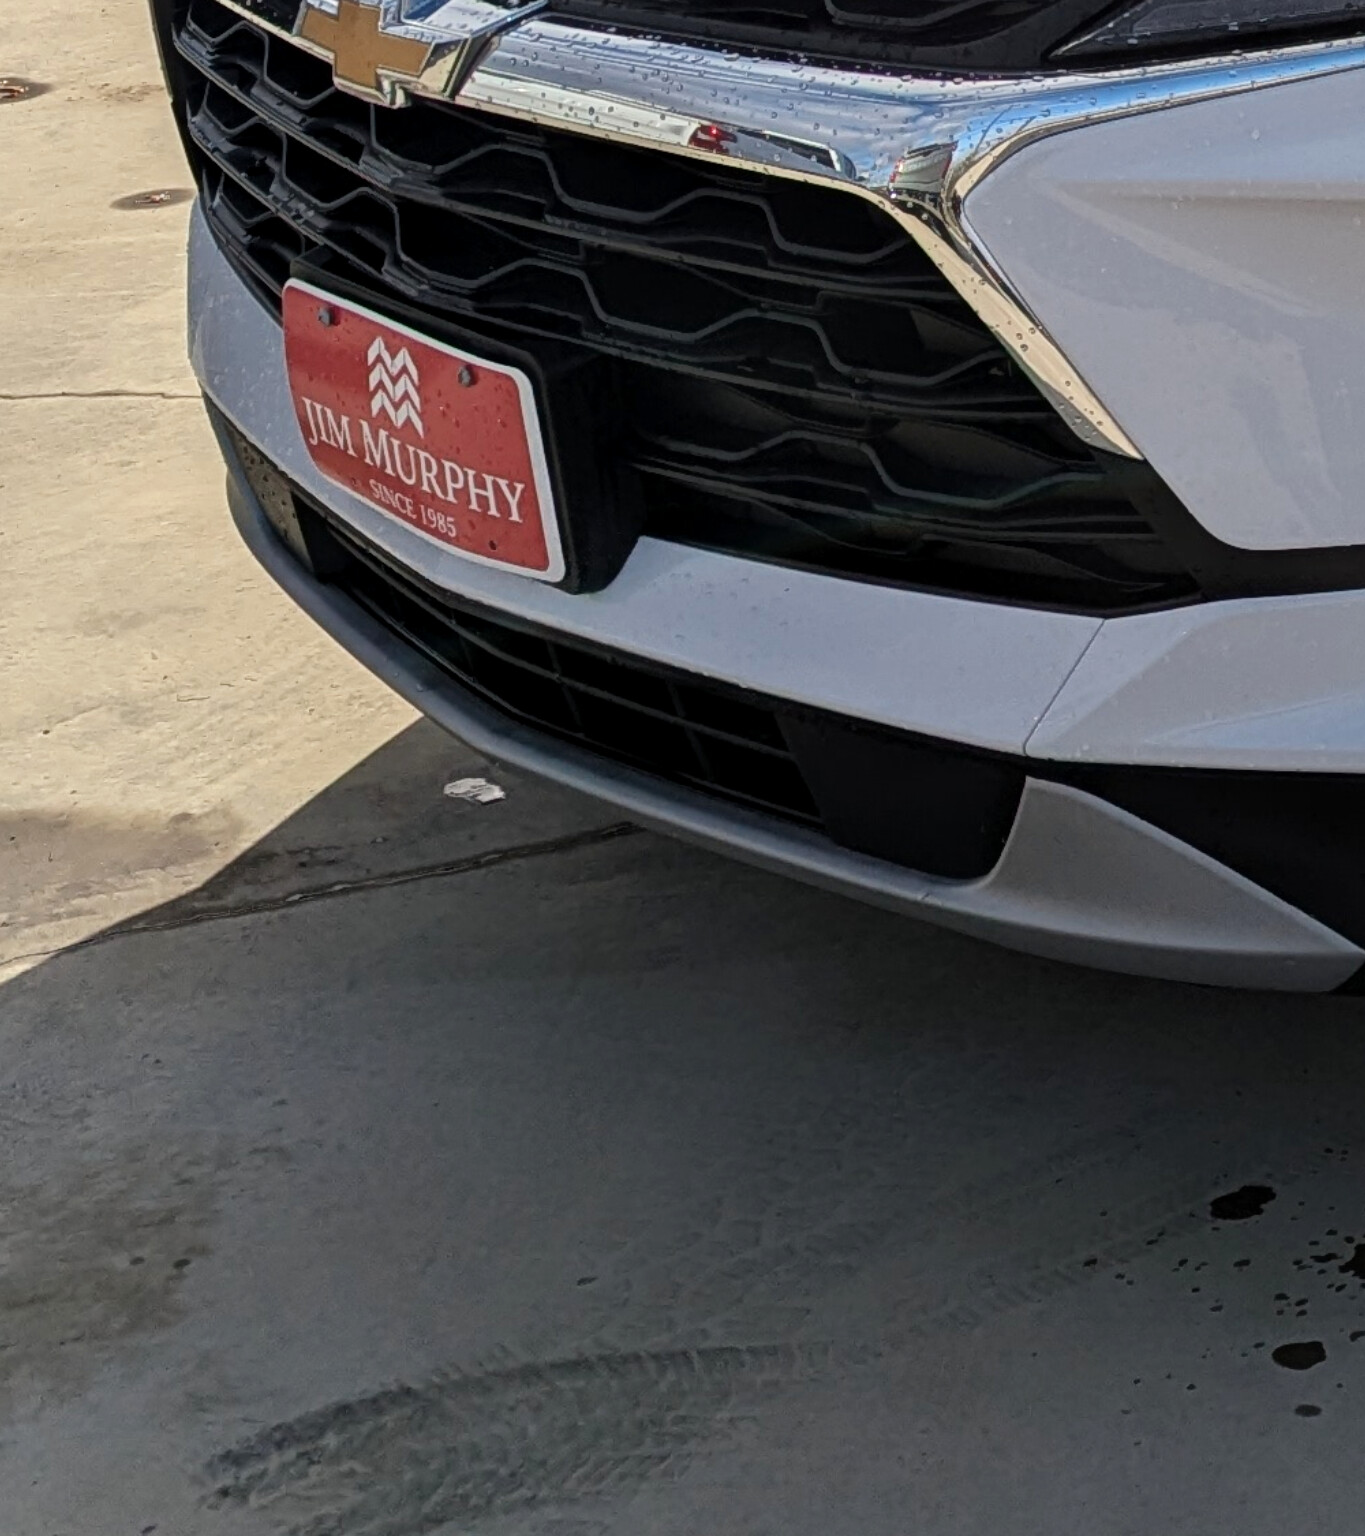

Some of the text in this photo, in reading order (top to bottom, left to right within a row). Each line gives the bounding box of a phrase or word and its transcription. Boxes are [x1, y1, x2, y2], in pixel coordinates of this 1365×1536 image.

[301, 396, 525, 523] JIM MURPHY
[368, 478, 457, 537] SINCE 1985
